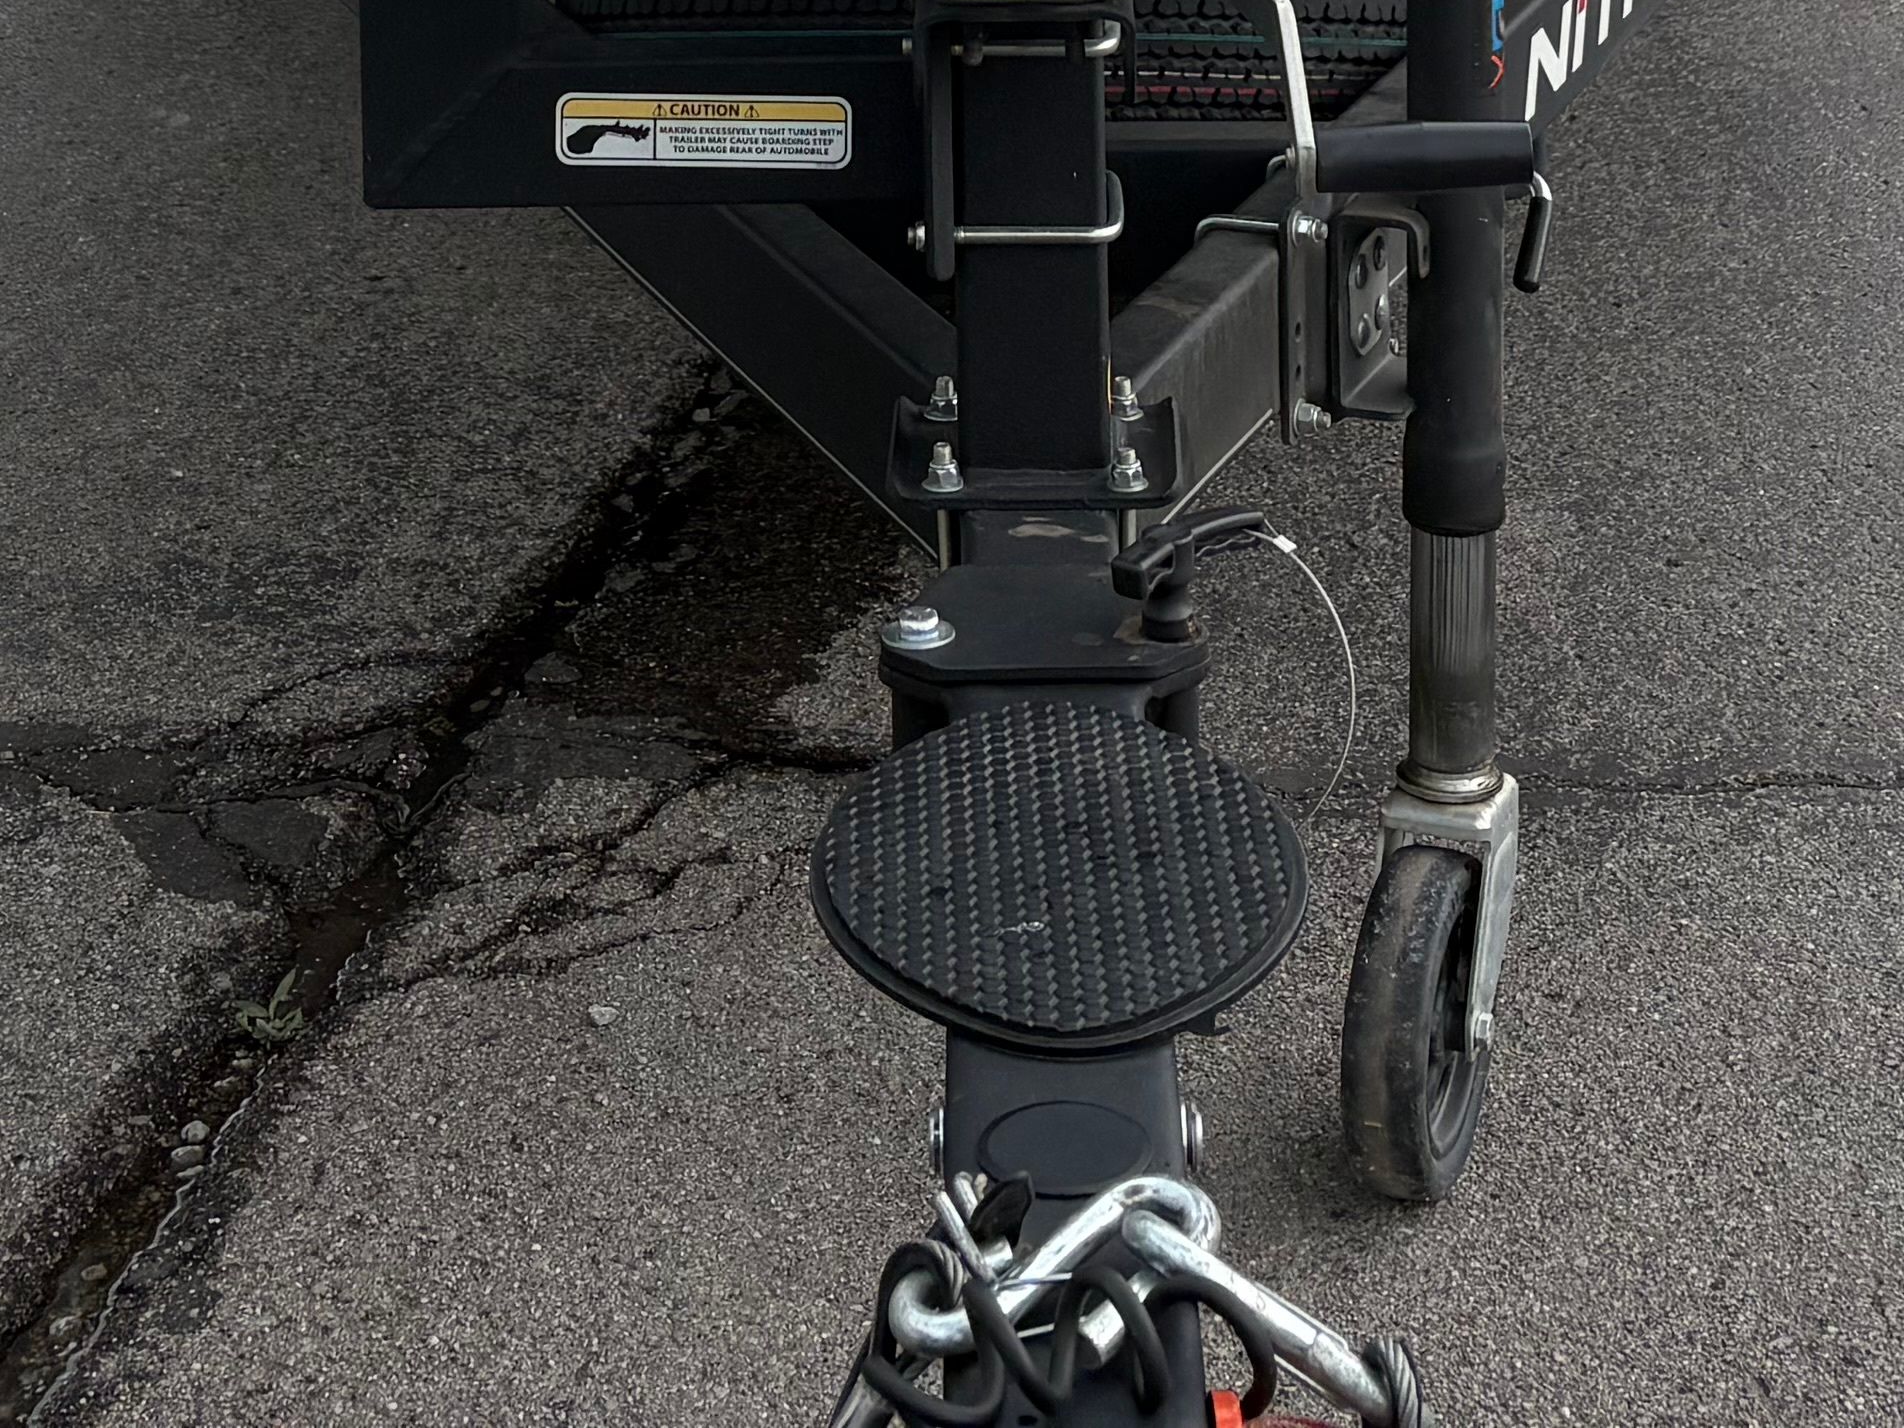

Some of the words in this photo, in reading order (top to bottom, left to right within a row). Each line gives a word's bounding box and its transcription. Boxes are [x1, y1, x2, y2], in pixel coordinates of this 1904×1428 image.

[669, 103, 741, 117] CAUTION
[659, 126, 697, 135] MAKING
[699, 127, 757, 136] EXCESSIVELY
[759, 127, 786, 136] TIGHT
[787, 128, 818, 137] TURNS
[819, 128, 844, 137] WITH
[668, 135, 706, 144] TRAILER
[707, 136, 728, 145] MAY
[729, 137, 760, 145] CAUSE
[761, 137, 811, 146] BOARDING
[673, 145, 686, 154] TO
[687, 145, 728, 154] DAMAGE
[729, 146, 754, 155] REAR
[755, 146, 768, 155] OF
[769, 147, 830, 156] AUTOMOBILE
